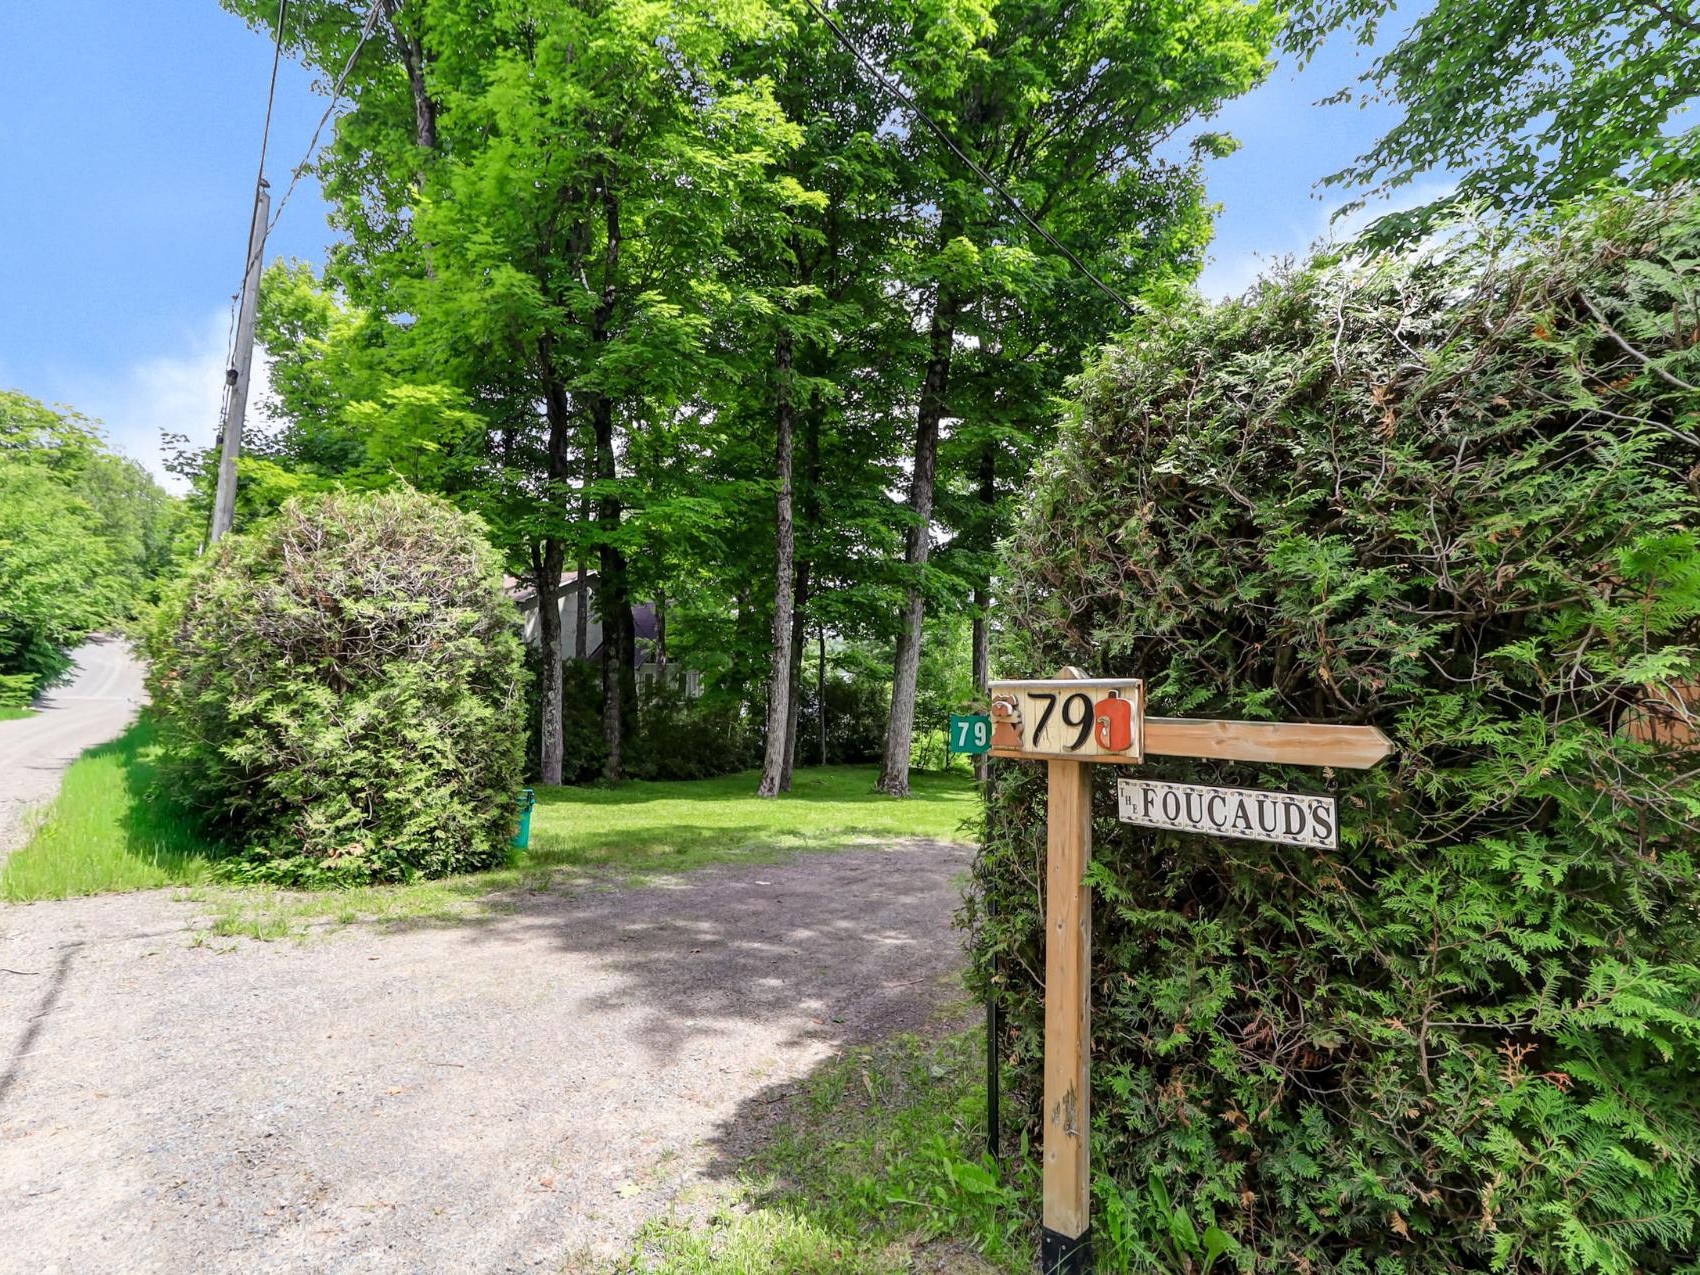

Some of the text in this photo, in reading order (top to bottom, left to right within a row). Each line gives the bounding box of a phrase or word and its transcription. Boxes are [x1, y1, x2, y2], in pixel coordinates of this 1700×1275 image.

[958, 721, 987, 747] 79
[1027, 692, 1095, 752] 79
[1120, 787, 1333, 840] THE FOUCAUD'S
